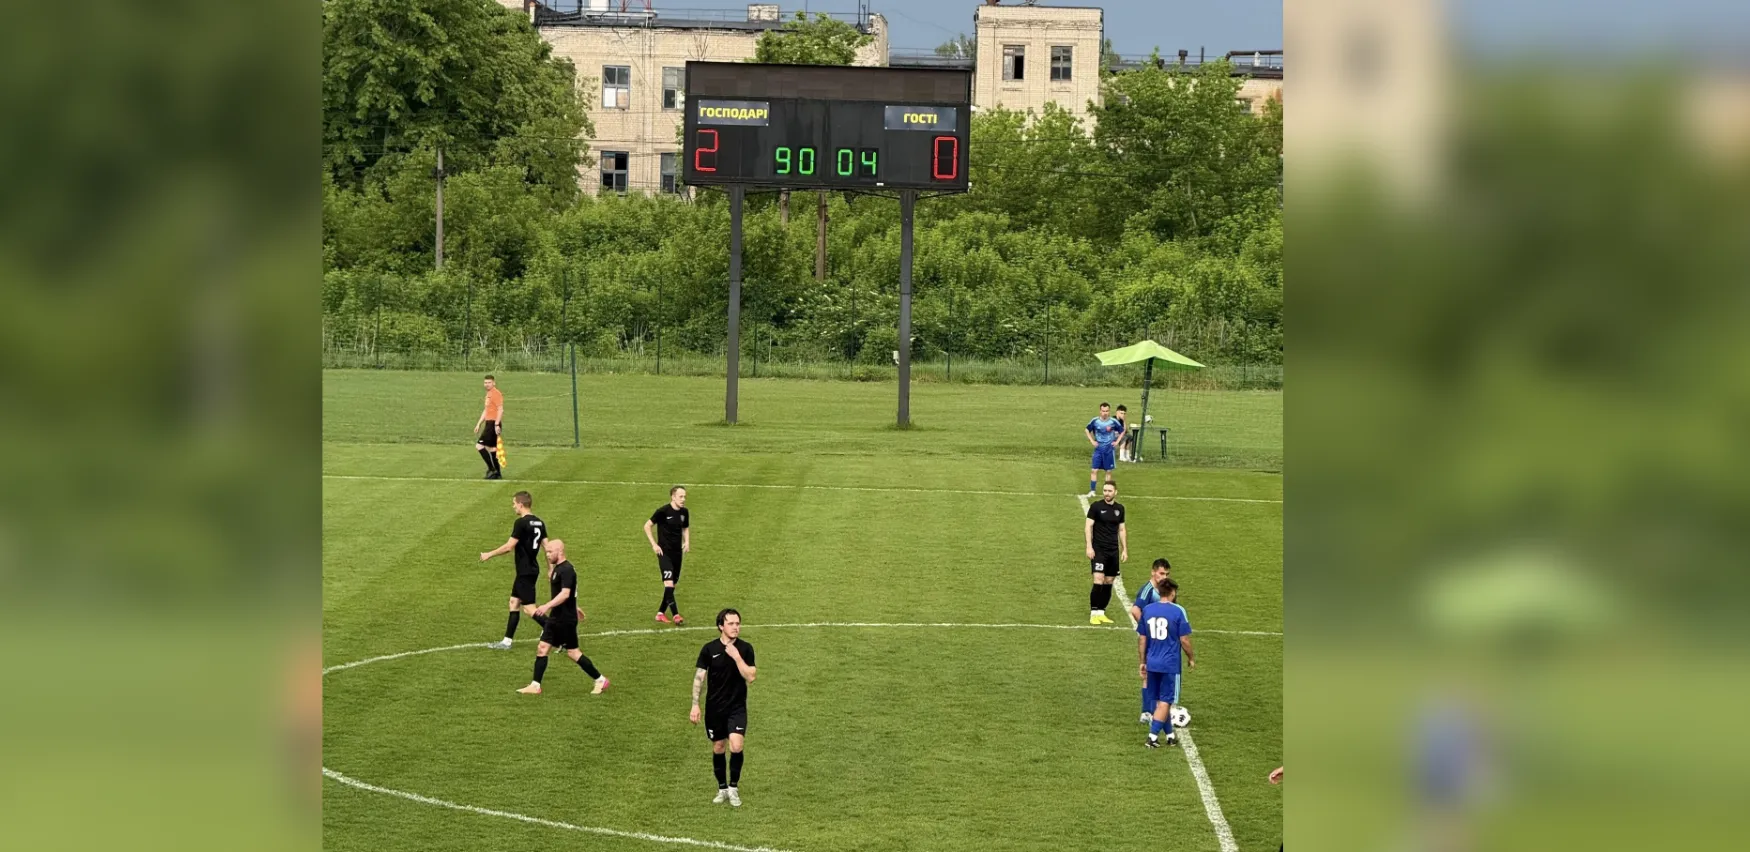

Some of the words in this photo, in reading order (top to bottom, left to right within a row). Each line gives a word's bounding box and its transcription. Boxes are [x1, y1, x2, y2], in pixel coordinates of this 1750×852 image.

[699, 107, 768, 120] ГОСПОДАРІ
[903, 113, 938, 124] ГОСТІ
[695, 129, 718, 171] 2
[933, 136, 958, 179] 0
[775, 147, 815, 175] 90
[837, 149, 877, 176] 04
[532, 527, 541, 549] 2
[663, 570, 673, 579] 77
[1095, 562, 1104, 571] 23
[1146, 616, 1168, 640] 18
